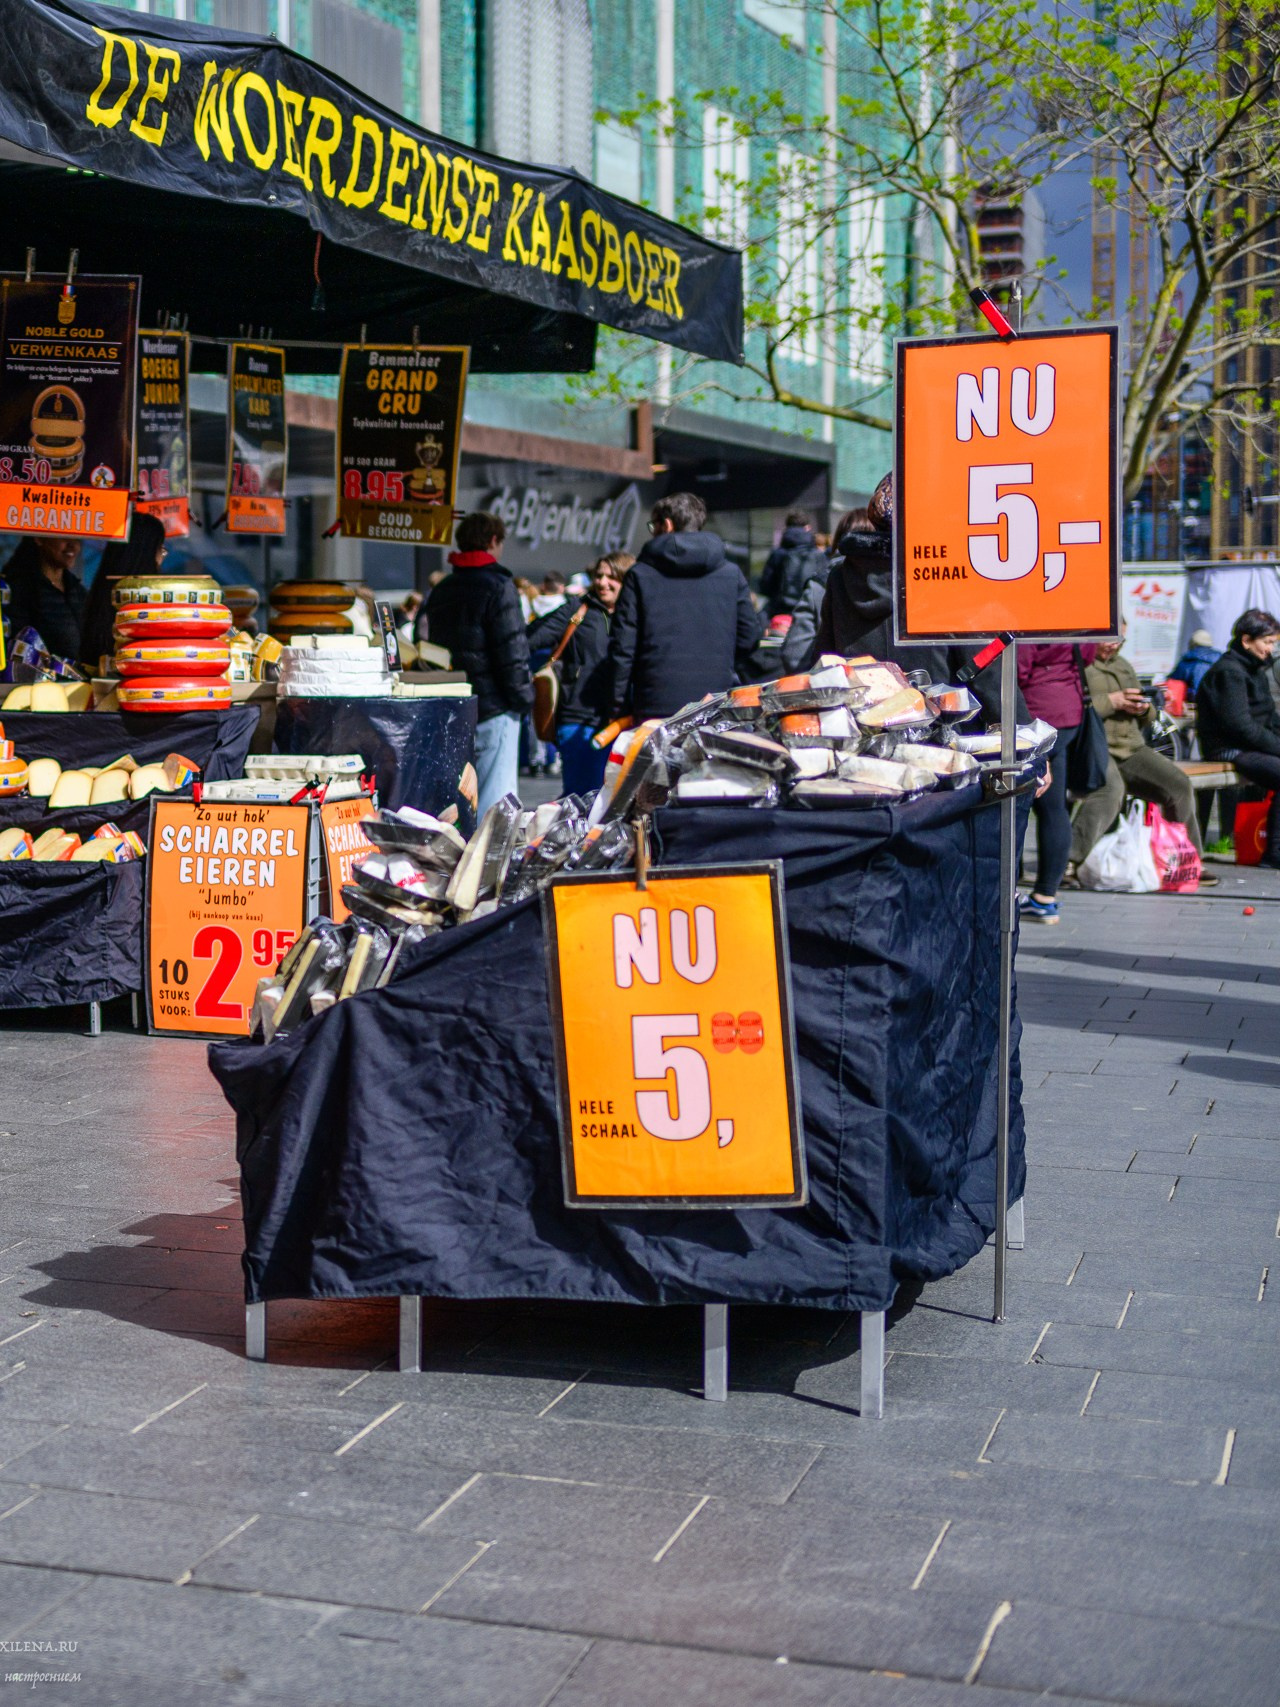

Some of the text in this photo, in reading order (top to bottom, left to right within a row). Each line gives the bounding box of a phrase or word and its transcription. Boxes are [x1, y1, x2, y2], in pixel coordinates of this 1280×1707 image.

[86, 25, 684, 321] DE WOERDENSE KAASBOER
[25, 326, 105, 339] NOBLE GOLD
[10, 343, 119, 359] VERWENKAAS
[369, 351, 440, 368] Bemmelaer
[142, 358, 180, 379] BOEREN
[366, 369, 438, 392] GRAND
[143, 383, 180, 405] JUNIOR
[955, 362, 1057, 443] NU
[249, 398, 270, 416] KAAS
[378, 392, 421, 415] CRU
[353, 416, 397, 430] Topkwaliteit
[343, 456, 396, 467] NU 500 GRAM
[22, 487, 91, 507] Kwaliteits
[6, 505, 105, 532] GARANTIE
[379, 512, 412, 528] GOUD
[368, 525, 423, 540] BEKROOND
[967, 462, 1102, 593] 5,-
[913, 545, 948, 560] HELE
[913, 565, 969, 581] SCHAAL
[217, 809, 238, 821] uut
[159, 825, 299, 857] SCHARREL
[179, 856, 276, 888] EIEREN
[189, 910, 264, 922] (bij aankoop van kaas)
[612, 905, 718, 989] NU
[158, 958, 188, 985] 10
[159, 990, 190, 1001] STUKS
[160, 1005, 191, 1016] VOOR:
[631, 1013, 735, 1148] 5,
[580, 1100, 615, 1115] HELE
[581, 1124, 638, 1139] SCHAAL
